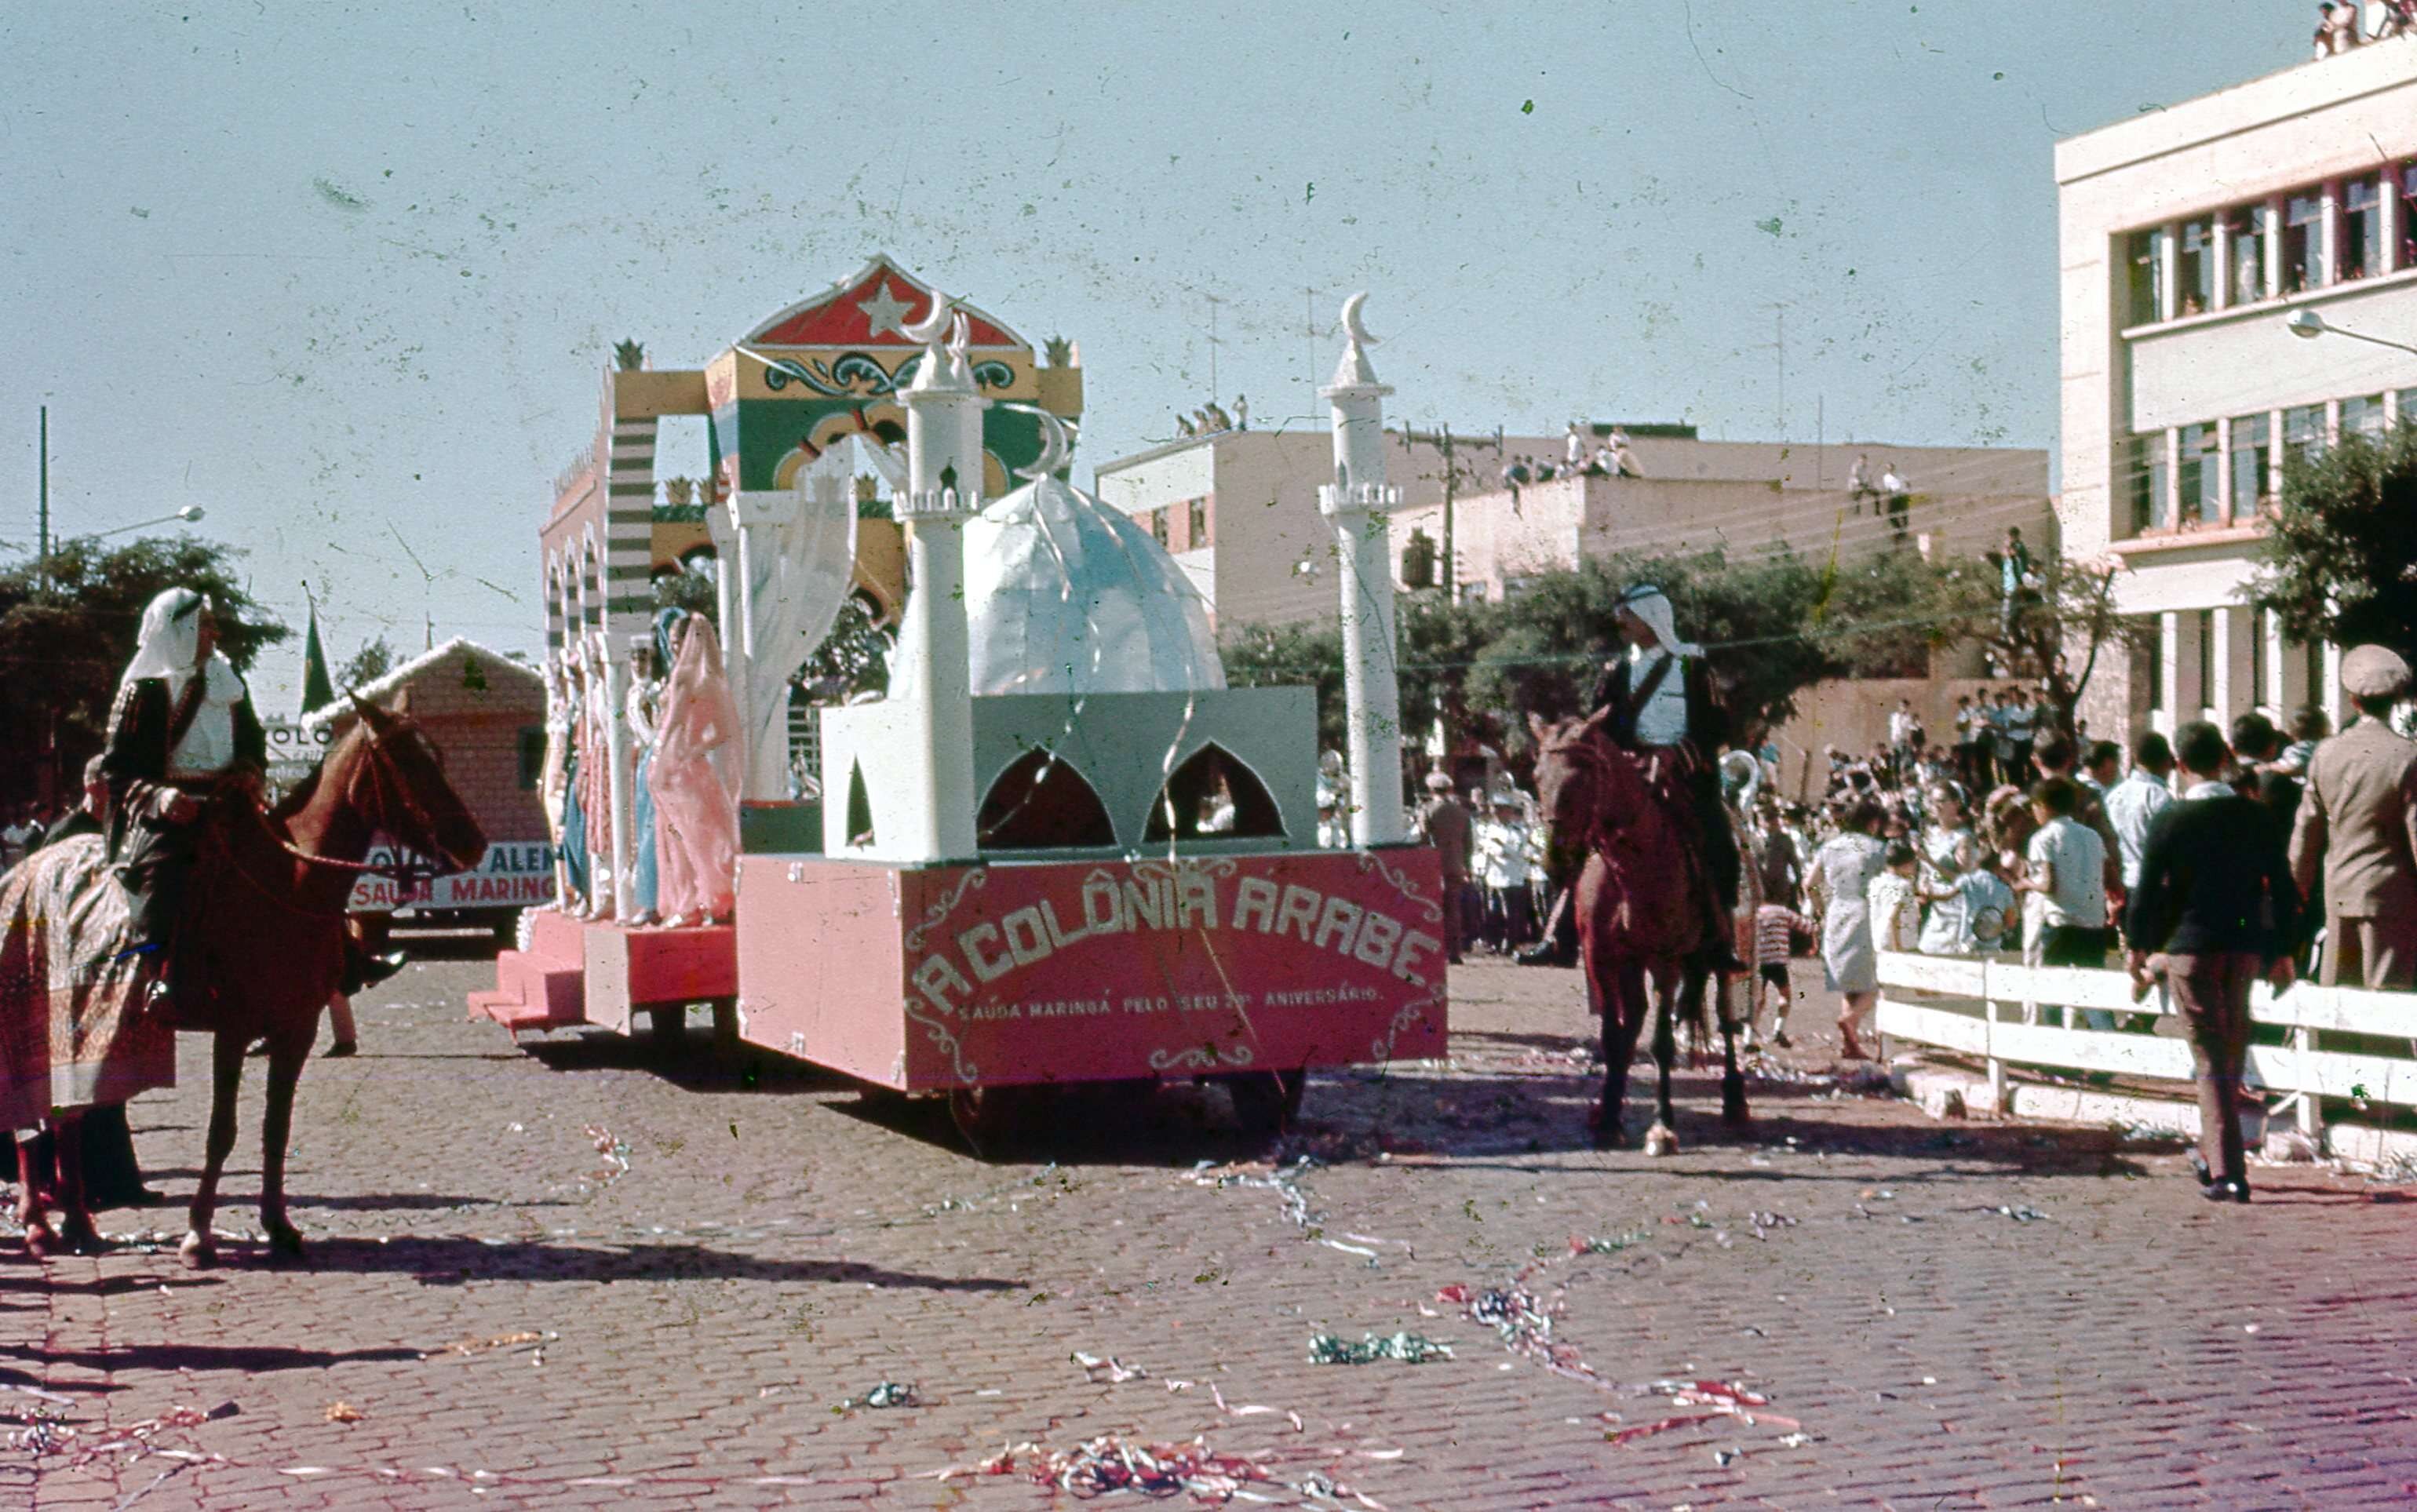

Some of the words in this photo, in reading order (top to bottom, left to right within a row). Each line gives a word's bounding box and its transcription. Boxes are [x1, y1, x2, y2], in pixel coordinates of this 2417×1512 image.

[912, 953, 972, 1015] A
[957, 868, 1218, 982] COLÔNIA
[1029, 988, 1111, 1017] MARINGÁ
[1124, 996, 1168, 1013] PELO
[1179, 993, 1218, 1011] SEU
